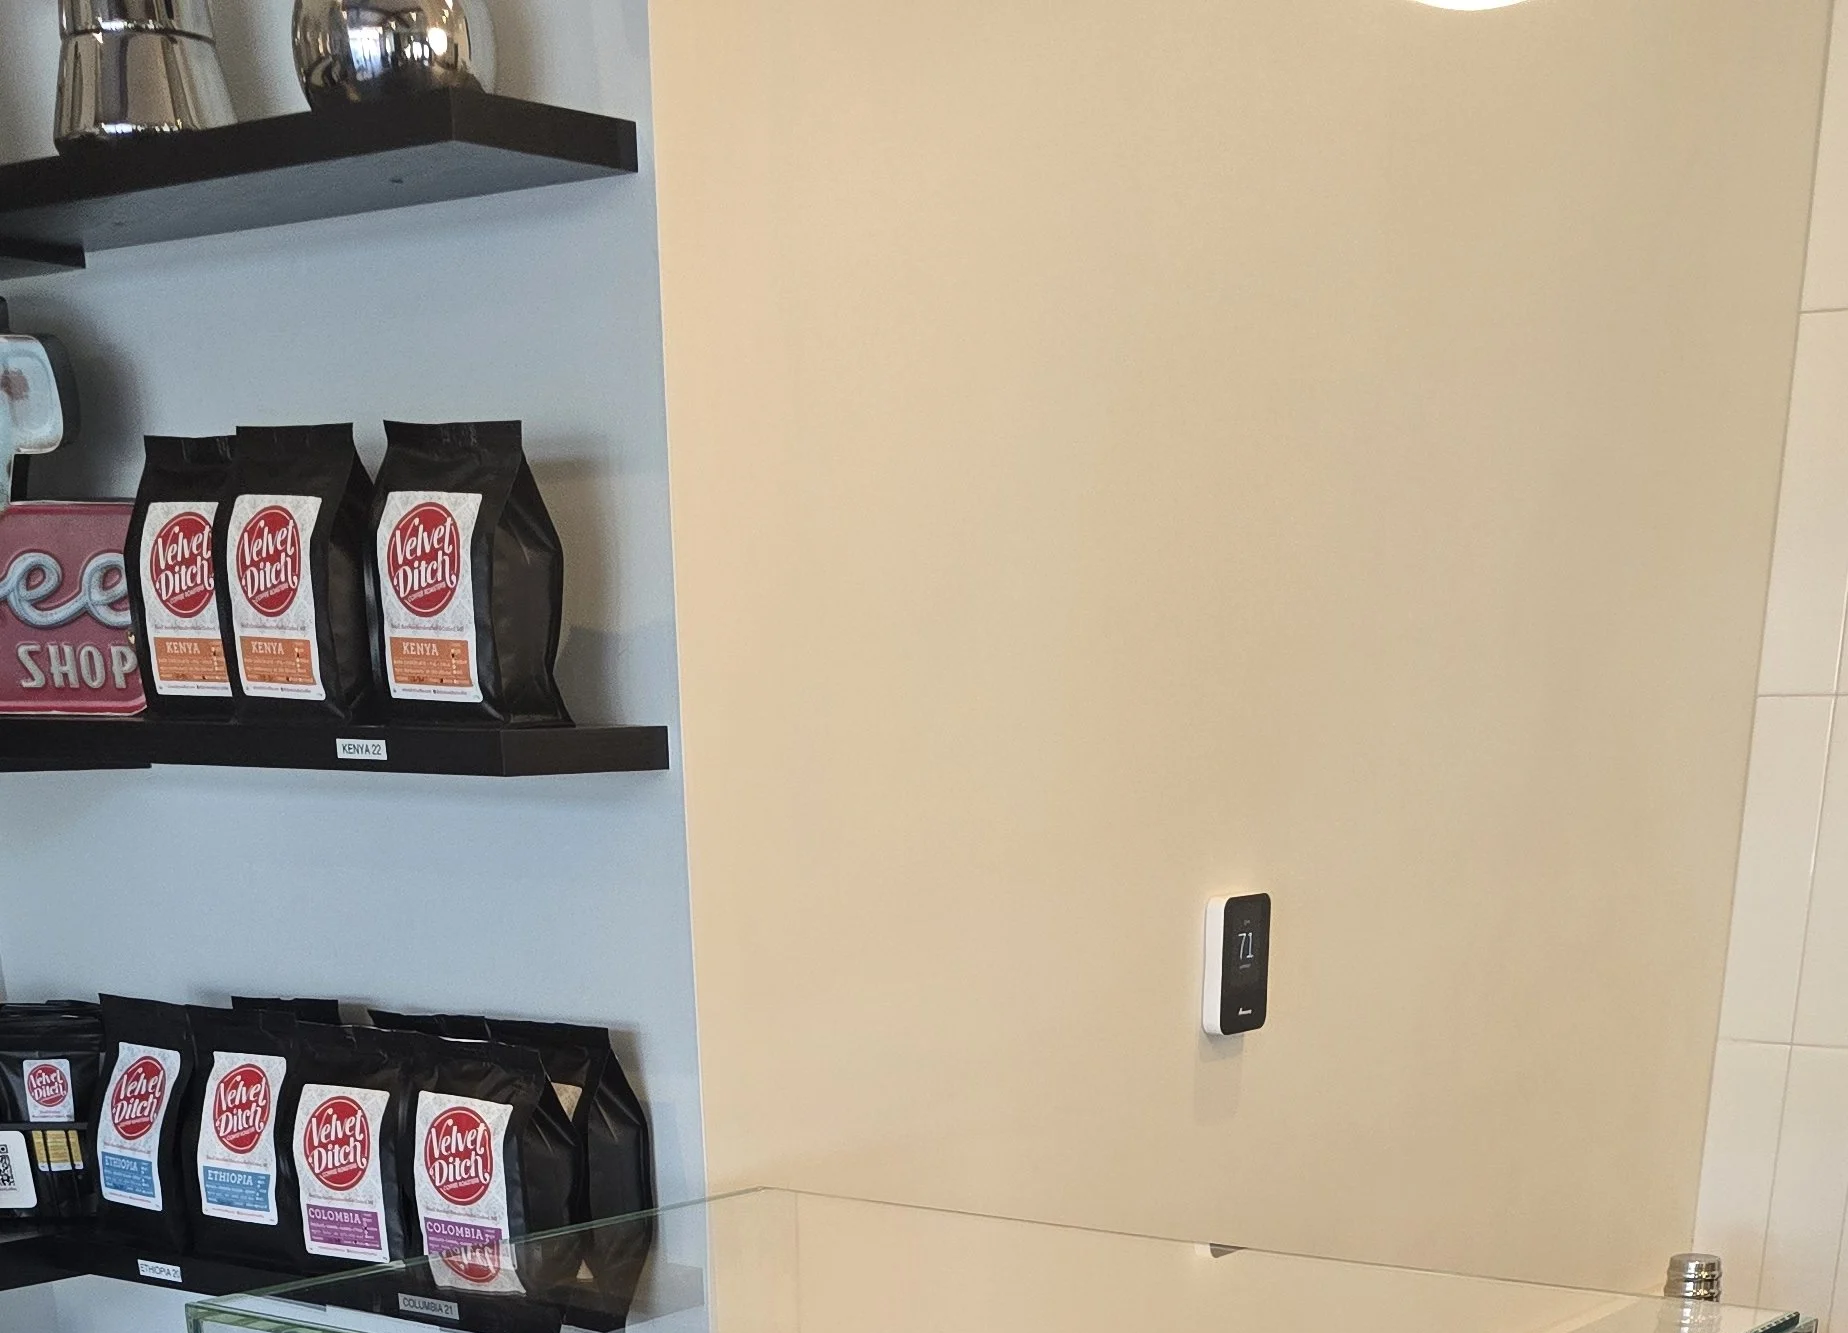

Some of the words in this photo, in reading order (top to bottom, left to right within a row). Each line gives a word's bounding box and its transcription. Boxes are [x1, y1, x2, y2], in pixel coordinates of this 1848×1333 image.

[157, 525, 212, 569] Velvet
[243, 519, 295, 566] Velvet
[395, 517, 454, 565] Velvet
[156, 556, 215, 600] Ditch
[241, 552, 298, 598] Ditch
[393, 550, 457, 598] Ditch
[166, 641, 201, 654] KENYA
[251, 641, 285, 655] KENYA
[402, 641, 439, 656] KENYA
[18, 643, 138, 688] SHOP
[341, 743, 370, 755] KENYA
[371, 744, 382, 755] 22
[1237, 932, 1254, 960] 71
[119, 1067, 164, 1099] Velvet
[219, 1075, 266, 1110] Velvet
[112, 1094, 157, 1124] Ditch
[215, 1103, 264, 1136] Ditch
[311, 1107, 363, 1146] Velvet
[430, 1118, 486, 1159] Velvet
[104, 1155, 138, 1171] ETHIOPIA
[308, 1137, 367, 1174] Ditch
[429, 1150, 490, 1187] Ditch
[207, 1169, 253, 1186] ETHIOPIA
[308, 1207, 361, 1225] COLOMBIA
[426, 1221, 483, 1241] COLOMBIA
[140, 1263, 171, 1277] ETHIOPIA
[402, 1297, 443, 1313] COLUMBIA
[444, 1304, 453, 1315] 21
